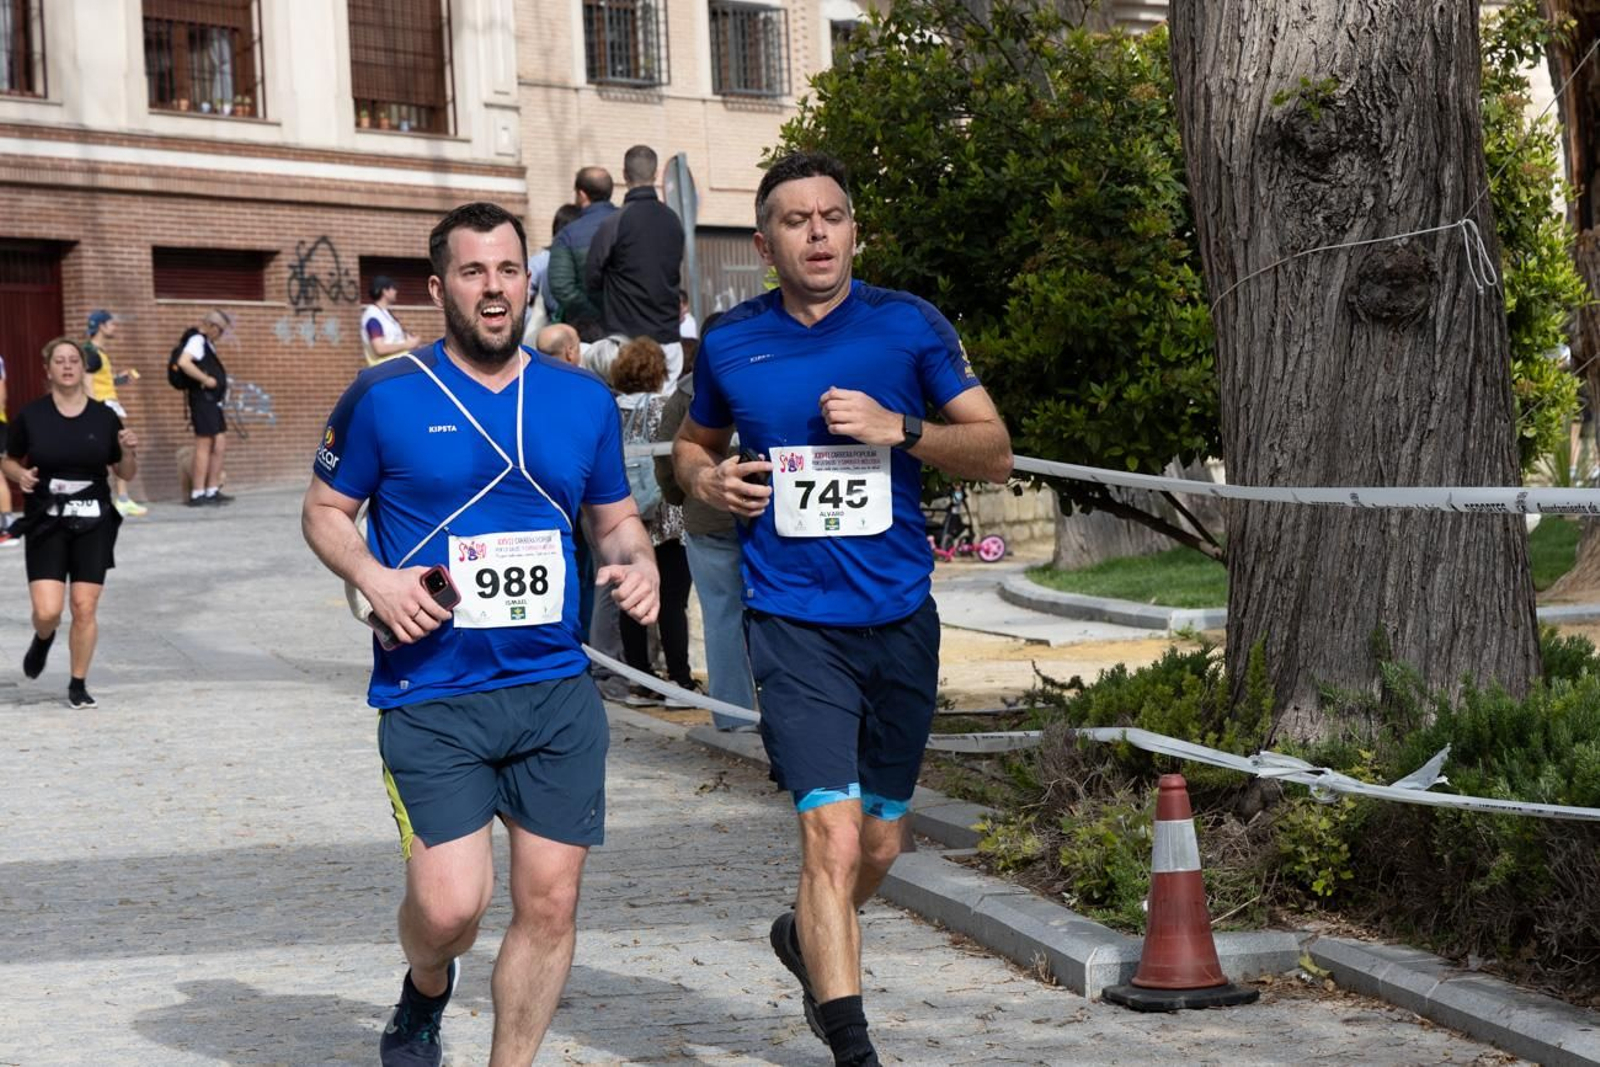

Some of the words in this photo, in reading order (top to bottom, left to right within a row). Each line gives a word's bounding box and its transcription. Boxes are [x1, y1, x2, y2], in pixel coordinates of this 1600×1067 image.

[429, 425, 457, 433] KIPSTA
[795, 480, 869, 509] 745
[475, 565, 549, 599] 988
